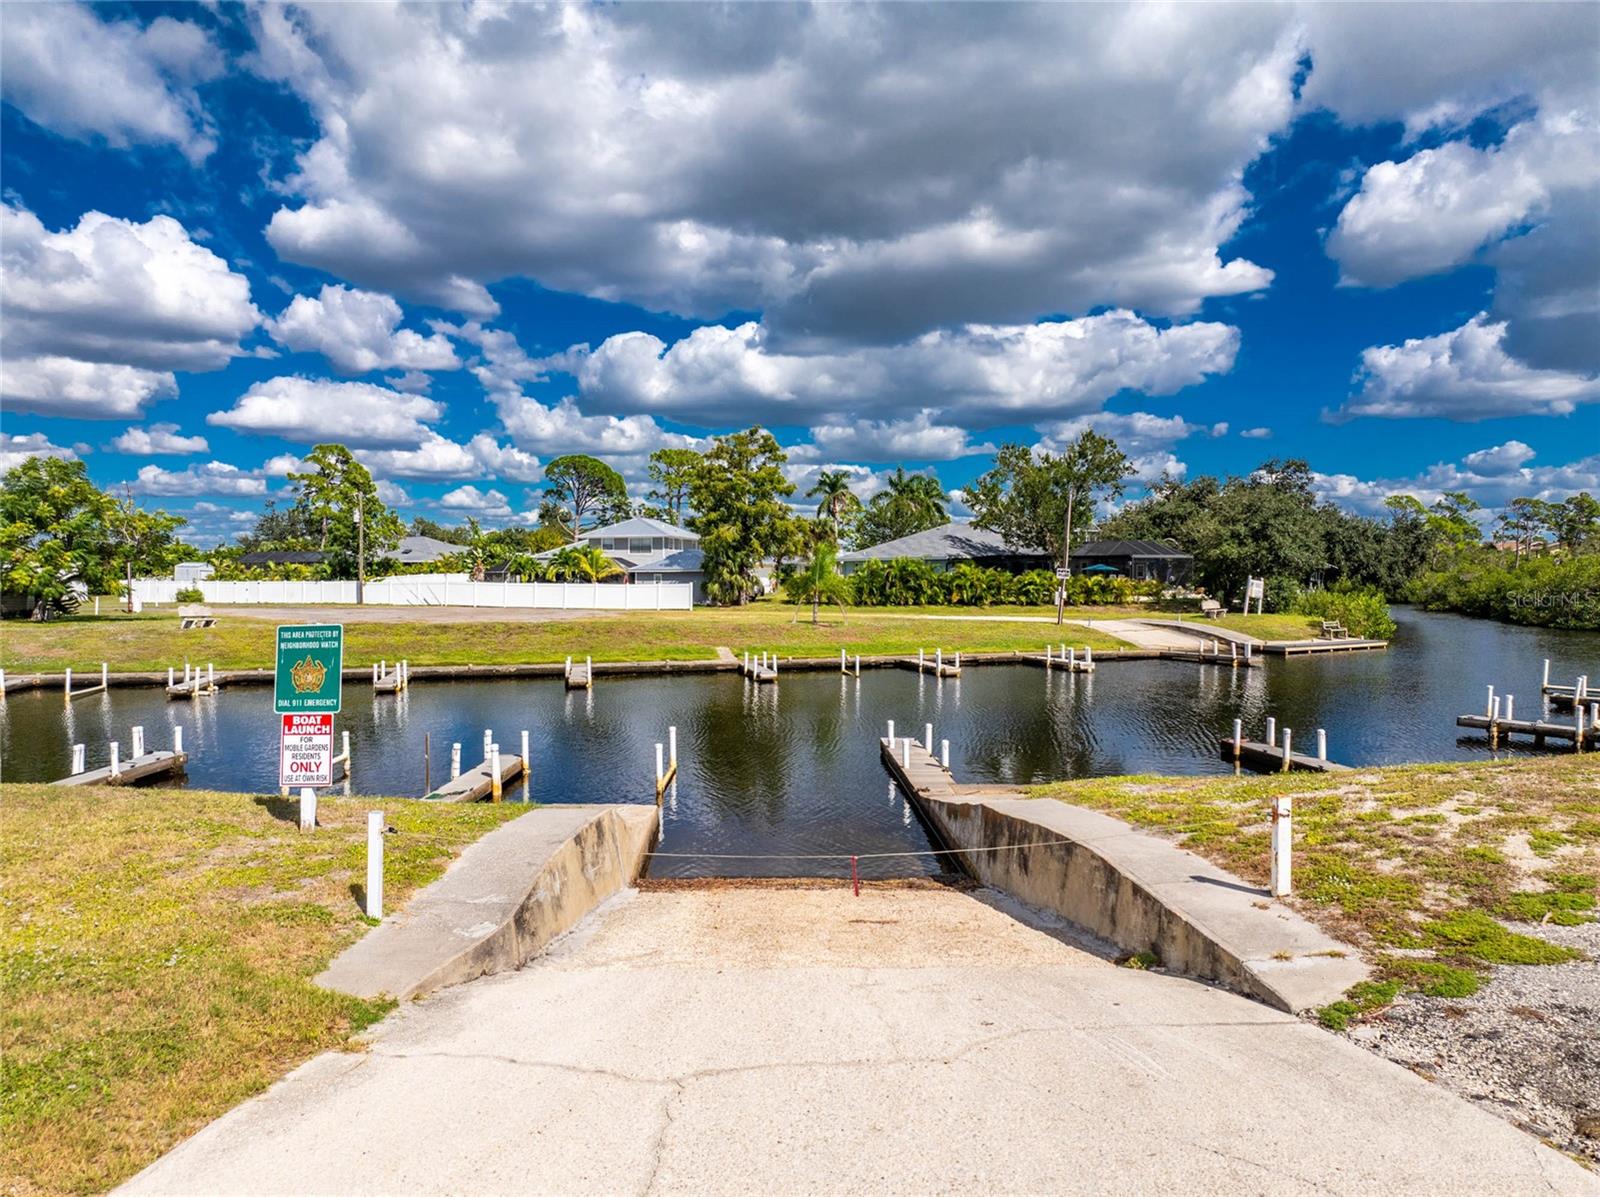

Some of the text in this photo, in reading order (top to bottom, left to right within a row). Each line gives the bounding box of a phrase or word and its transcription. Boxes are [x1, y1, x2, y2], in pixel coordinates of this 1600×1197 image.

[280, 631, 291, 639] THIS
[280, 641, 320, 649] NEIGHBORHOOD
[292, 716, 322, 724] BOAT
[284, 725, 330, 734] LAUNCH
[290, 762, 322, 772] ONLY
